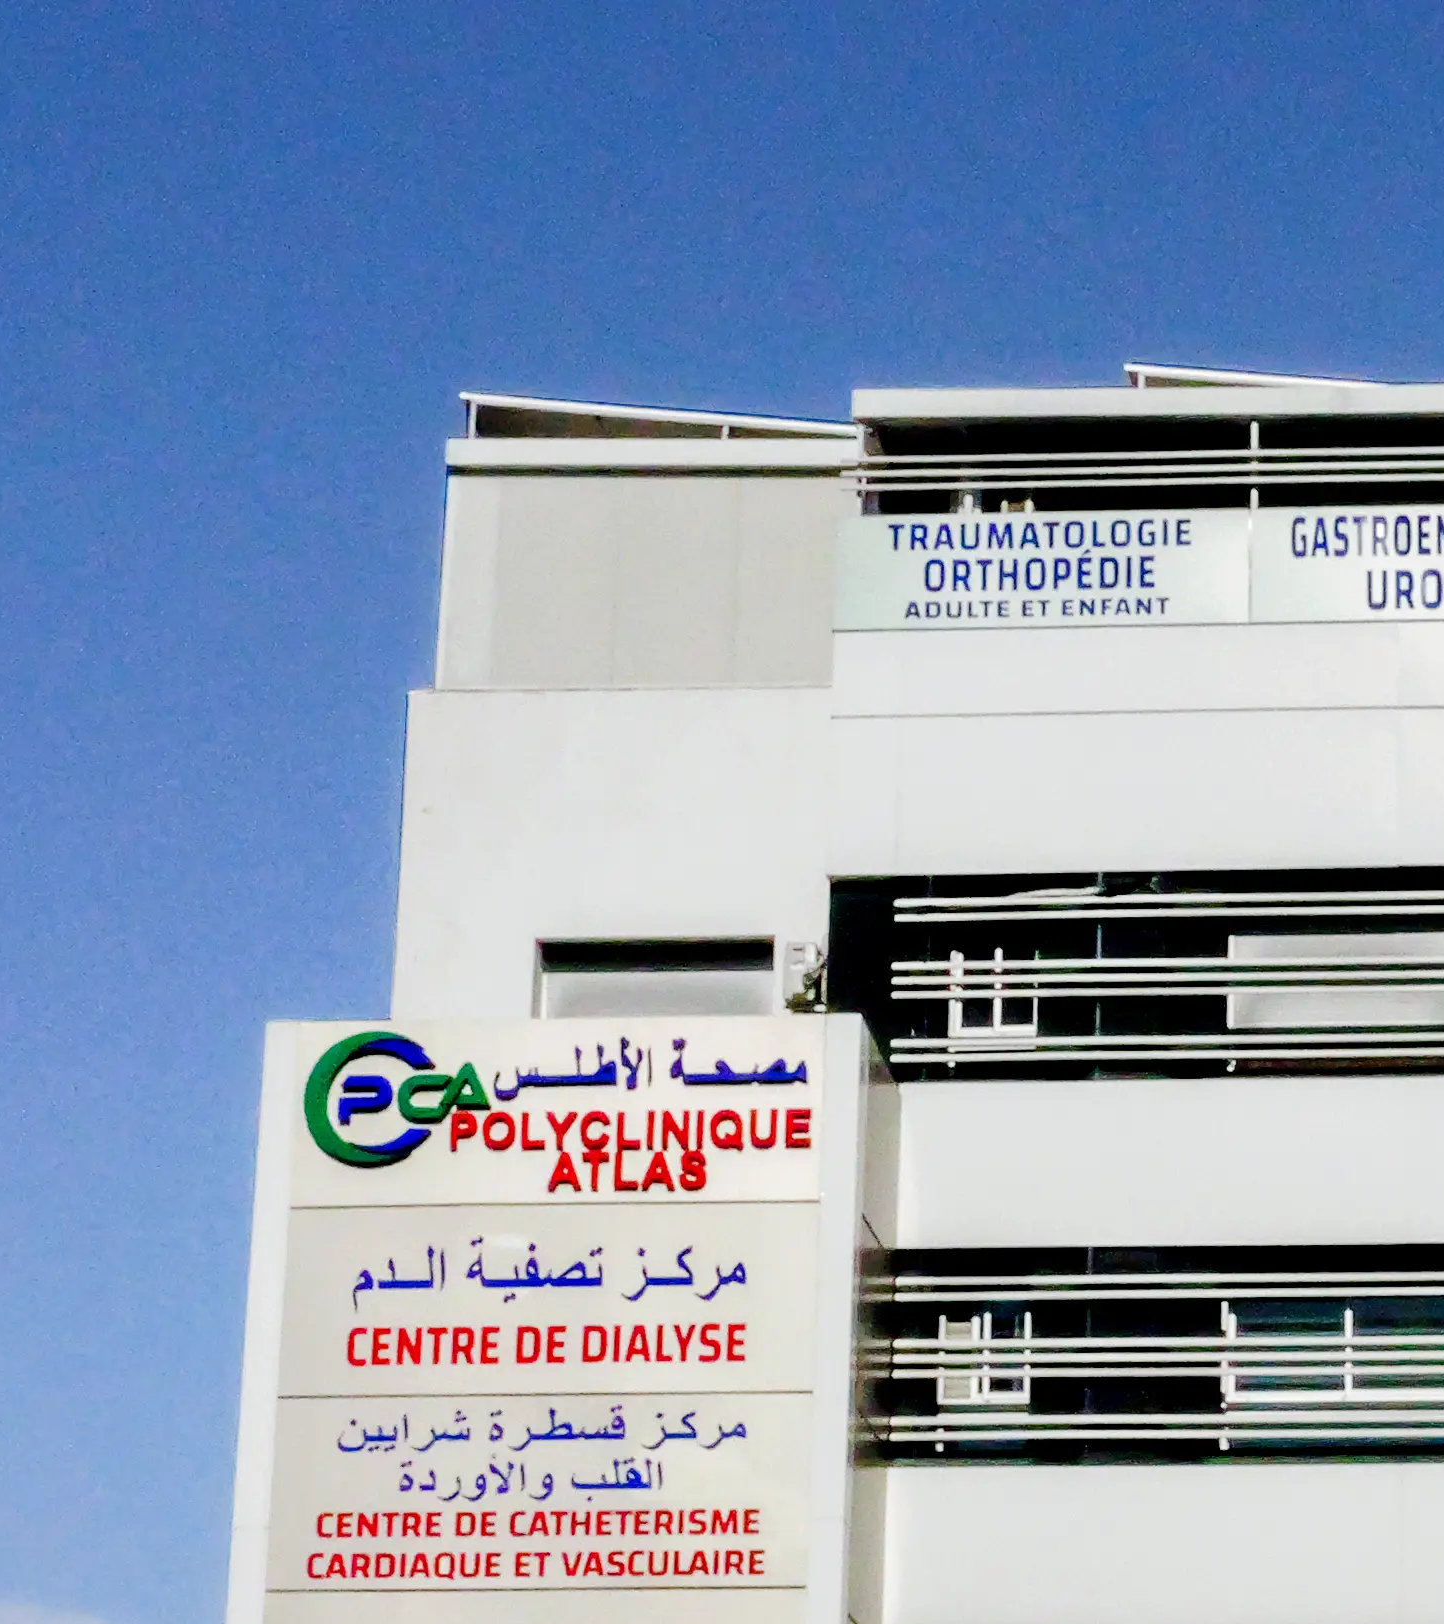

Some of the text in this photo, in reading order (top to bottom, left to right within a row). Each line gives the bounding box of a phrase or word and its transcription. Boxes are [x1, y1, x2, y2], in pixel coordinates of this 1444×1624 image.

[888, 517, 1193, 551] TRAUMATOLOGIE
[925, 551, 1154, 592] ORTHOPÉDIE
[905, 598, 1169, 619] ADULTE ET ENFANT
[494, 1037, 807, 1102] مصحة الأطلس
[449, 1107, 812, 1155] POLYCLINIQUE
[547, 1148, 708, 1193] ATLAS
[353, 1237, 747, 1310] مركز تصفية الدم
[347, 1323, 746, 1367] CENTRE DE DIALYSE
[338, 1405, 746, 1452] مركز قسطرة شرايين
[571, 1458, 662, 1501] القلب
[317, 1509, 759, 1538] CENTRE DE CATHETERISME
[307, 1550, 765, 1580] CARDIAQUE ET VASCULAIRE
